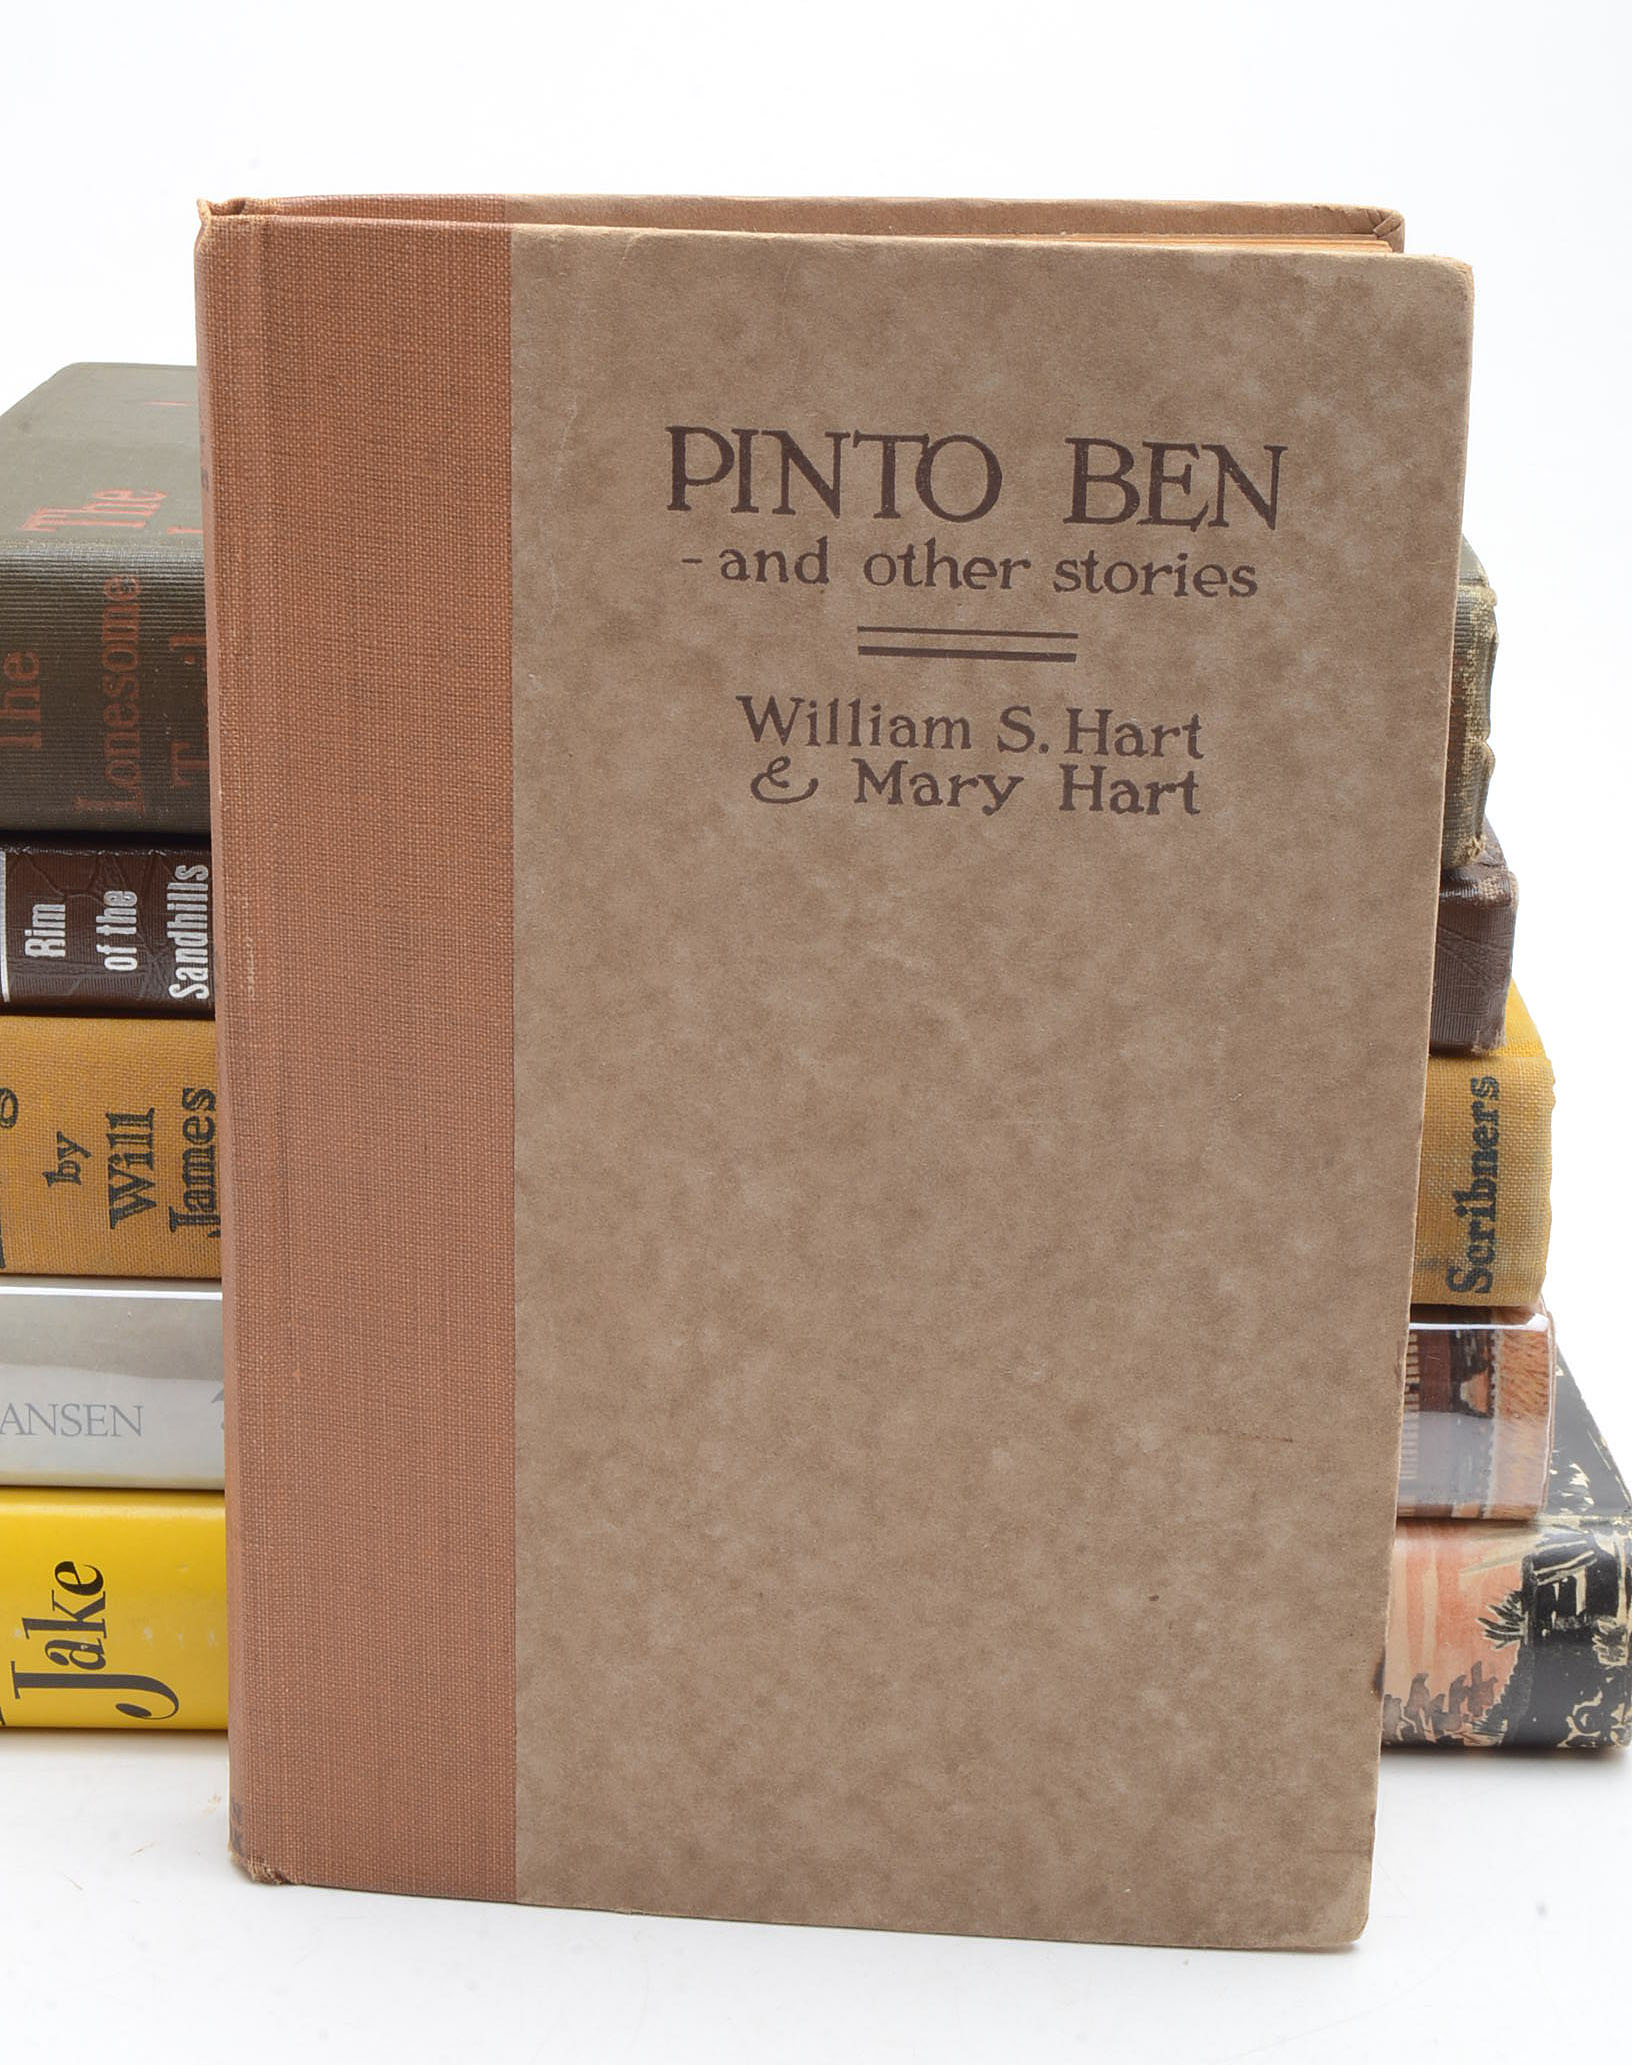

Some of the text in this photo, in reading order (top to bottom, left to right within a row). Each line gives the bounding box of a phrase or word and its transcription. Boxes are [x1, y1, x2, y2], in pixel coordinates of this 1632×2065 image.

[666, 426, 1288, 531] PINTO BEN
[863, 539, 1031, 590] other
[1053, 549, 1258, 598] stories
[74, 573, 143, 817] Lonesome
[736, 695, 1204, 759] William S. Hart
[750, 756, 1201, 816] & Mary Hart
[25, 904, 66, 957] Rim
[97, 891, 138, 972] of the
[167, 864, 210, 1000] Sandhills
[43, 1131, 91, 1187] by
[105, 1108, 157, 1229] Will
[169, 1087, 220, 1238] James
[1445, 1076, 1500, 1294] Scribners
[10, 1561, 179, 1720] Jake
